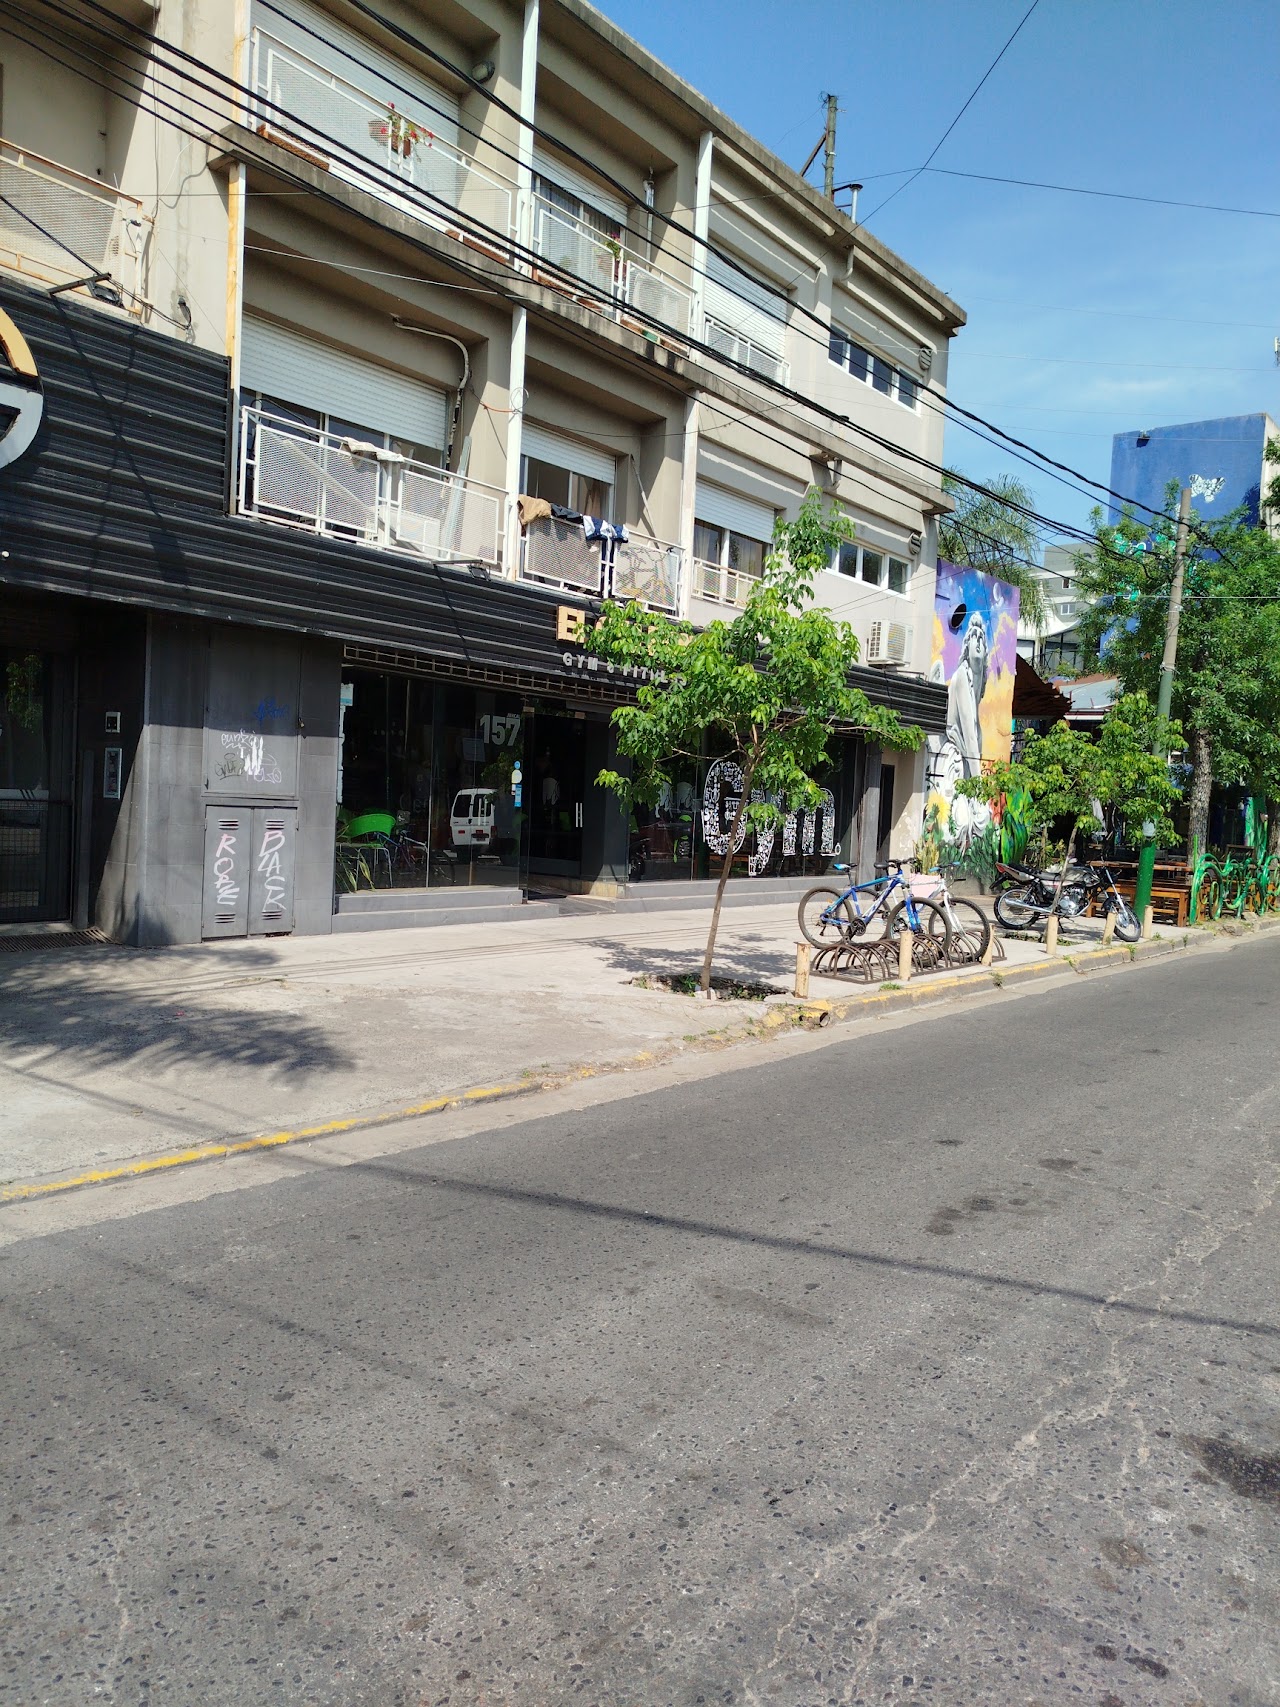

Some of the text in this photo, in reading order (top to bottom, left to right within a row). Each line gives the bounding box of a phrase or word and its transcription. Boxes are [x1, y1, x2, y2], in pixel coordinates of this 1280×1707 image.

[563, 652, 598, 671] GYM
[480, 714, 521, 747] 157
[257, 830, 287, 912] BLACK
